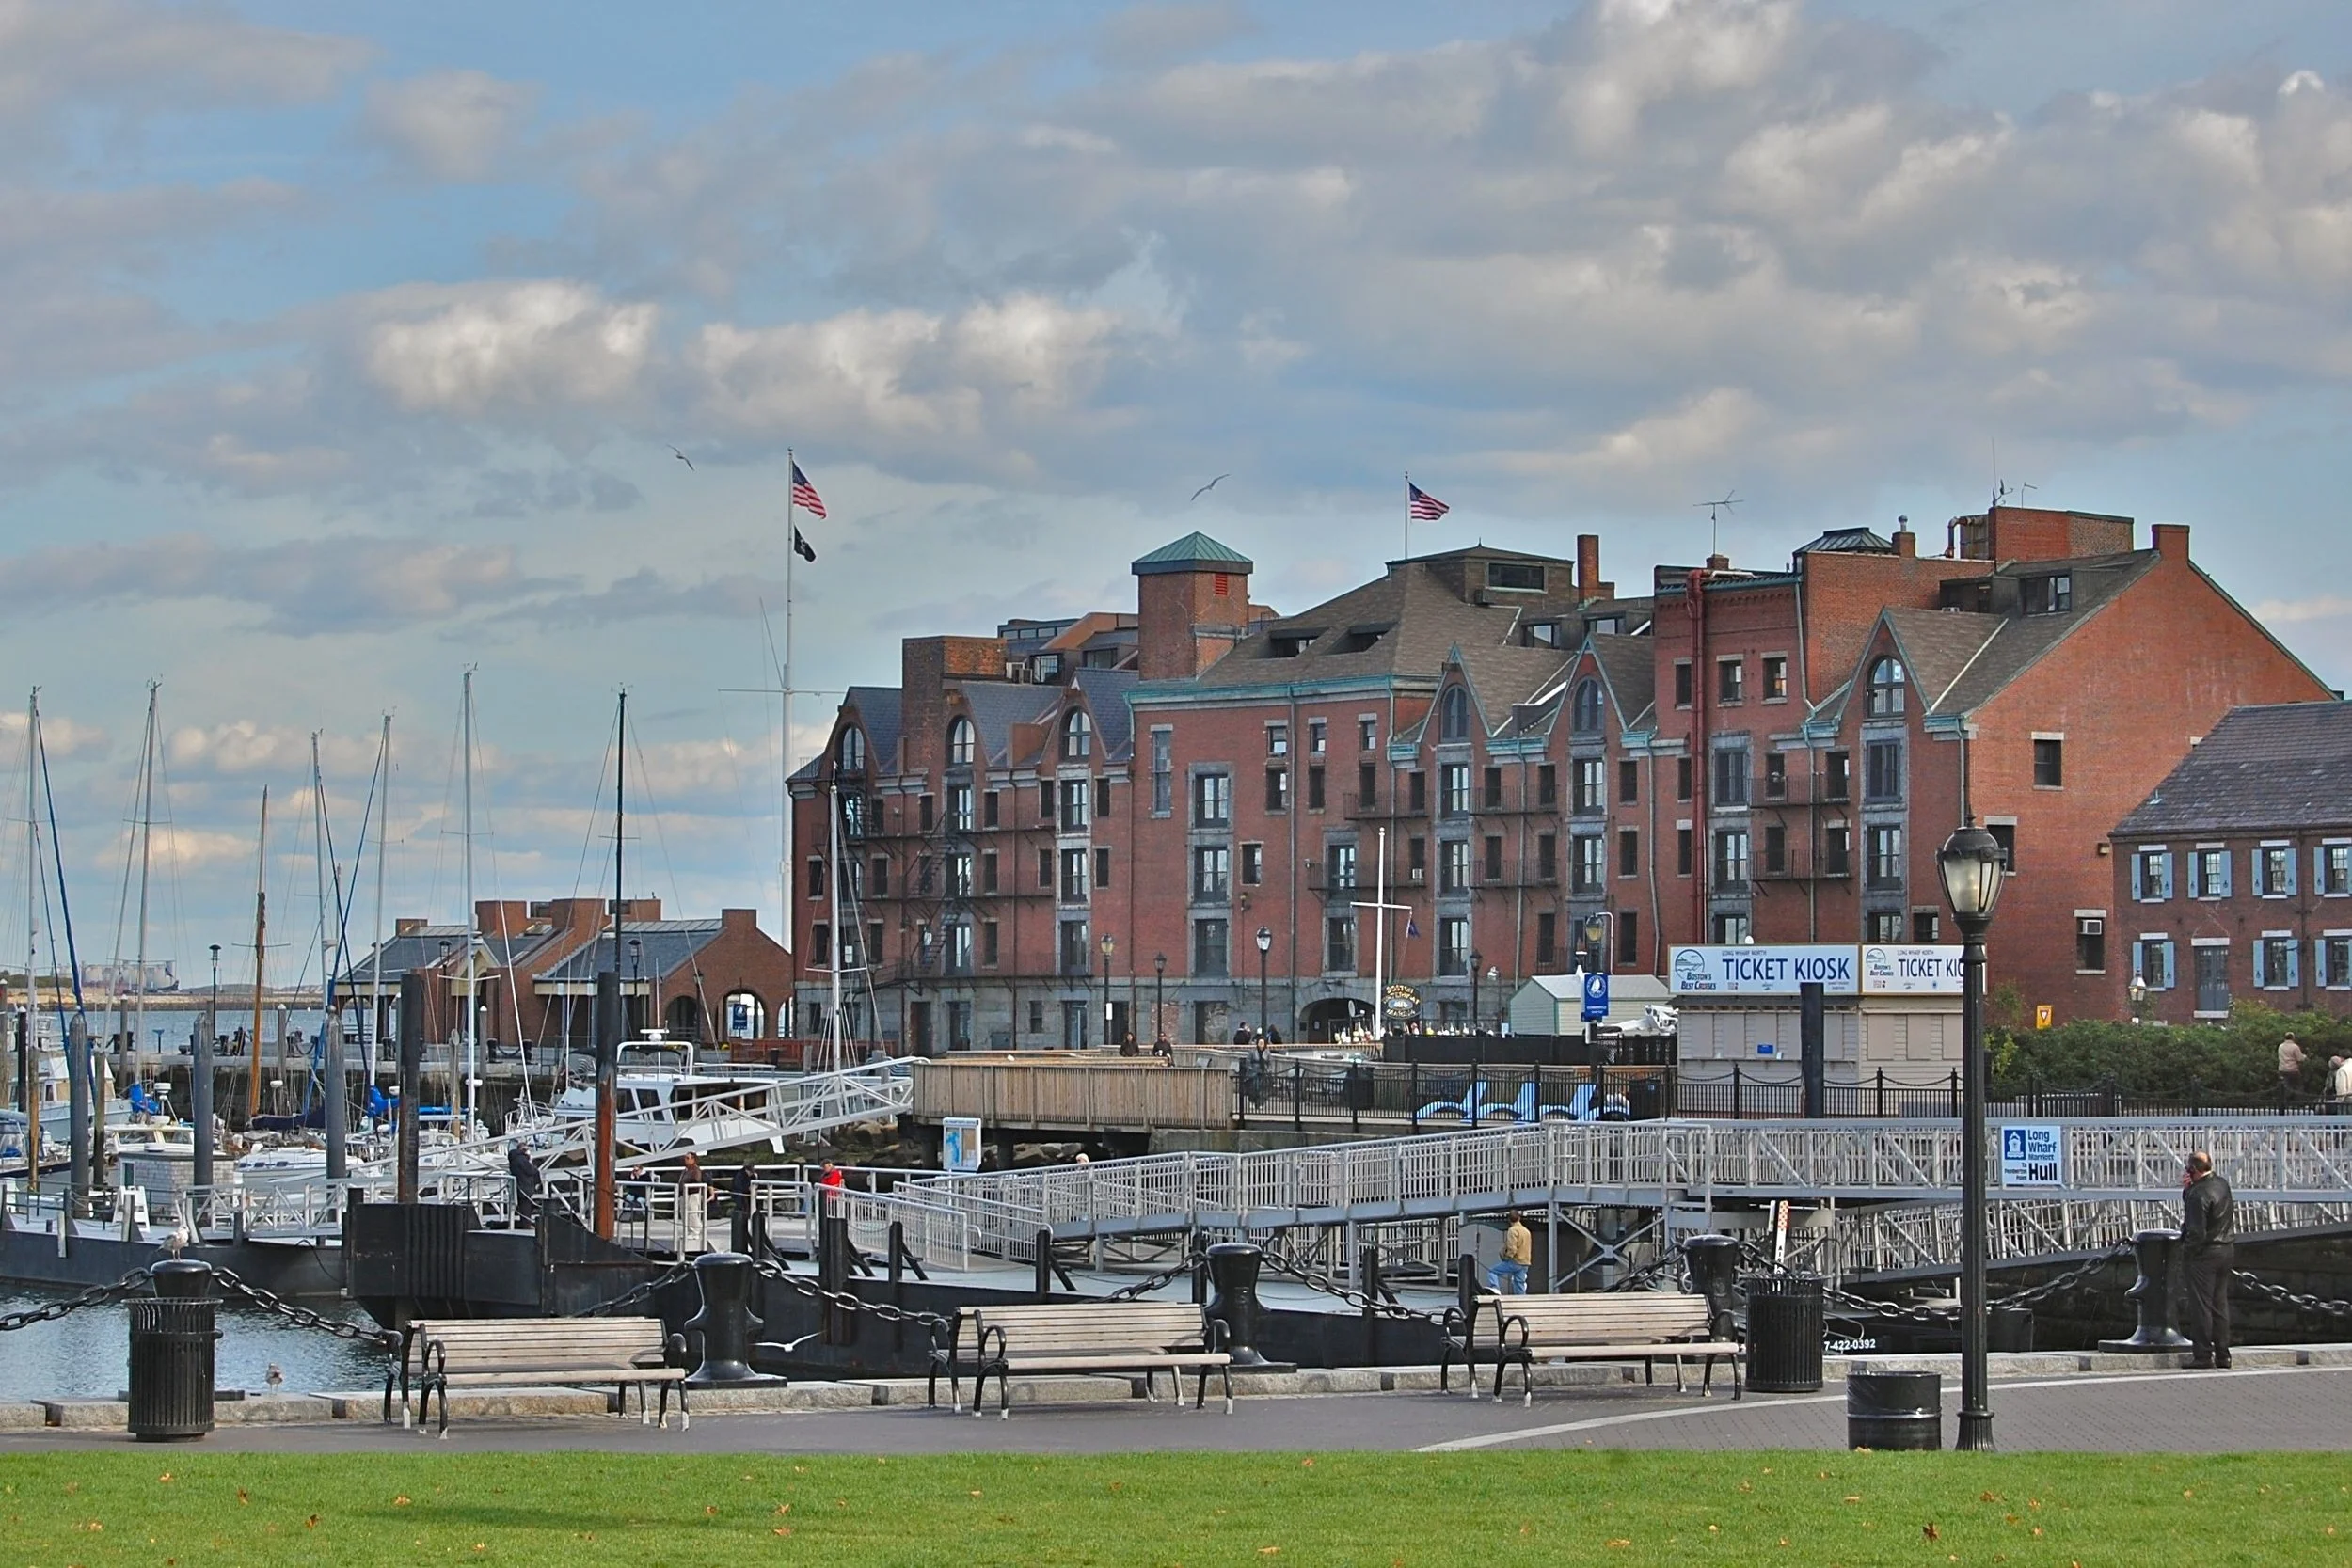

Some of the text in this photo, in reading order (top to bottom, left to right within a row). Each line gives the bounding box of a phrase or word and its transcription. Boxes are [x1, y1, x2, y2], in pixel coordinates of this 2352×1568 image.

[1723, 958, 1850, 980] TICKET KIOSK
[1899, 958, 1964, 977] TICKET KIO
[2028, 1130, 2050, 1143] Long
[2028, 1142, 2057, 1153] Wharf
[2029, 1163, 2058, 1181] Hull
[1824, 1338, 1876, 1351] 7-422-0392
